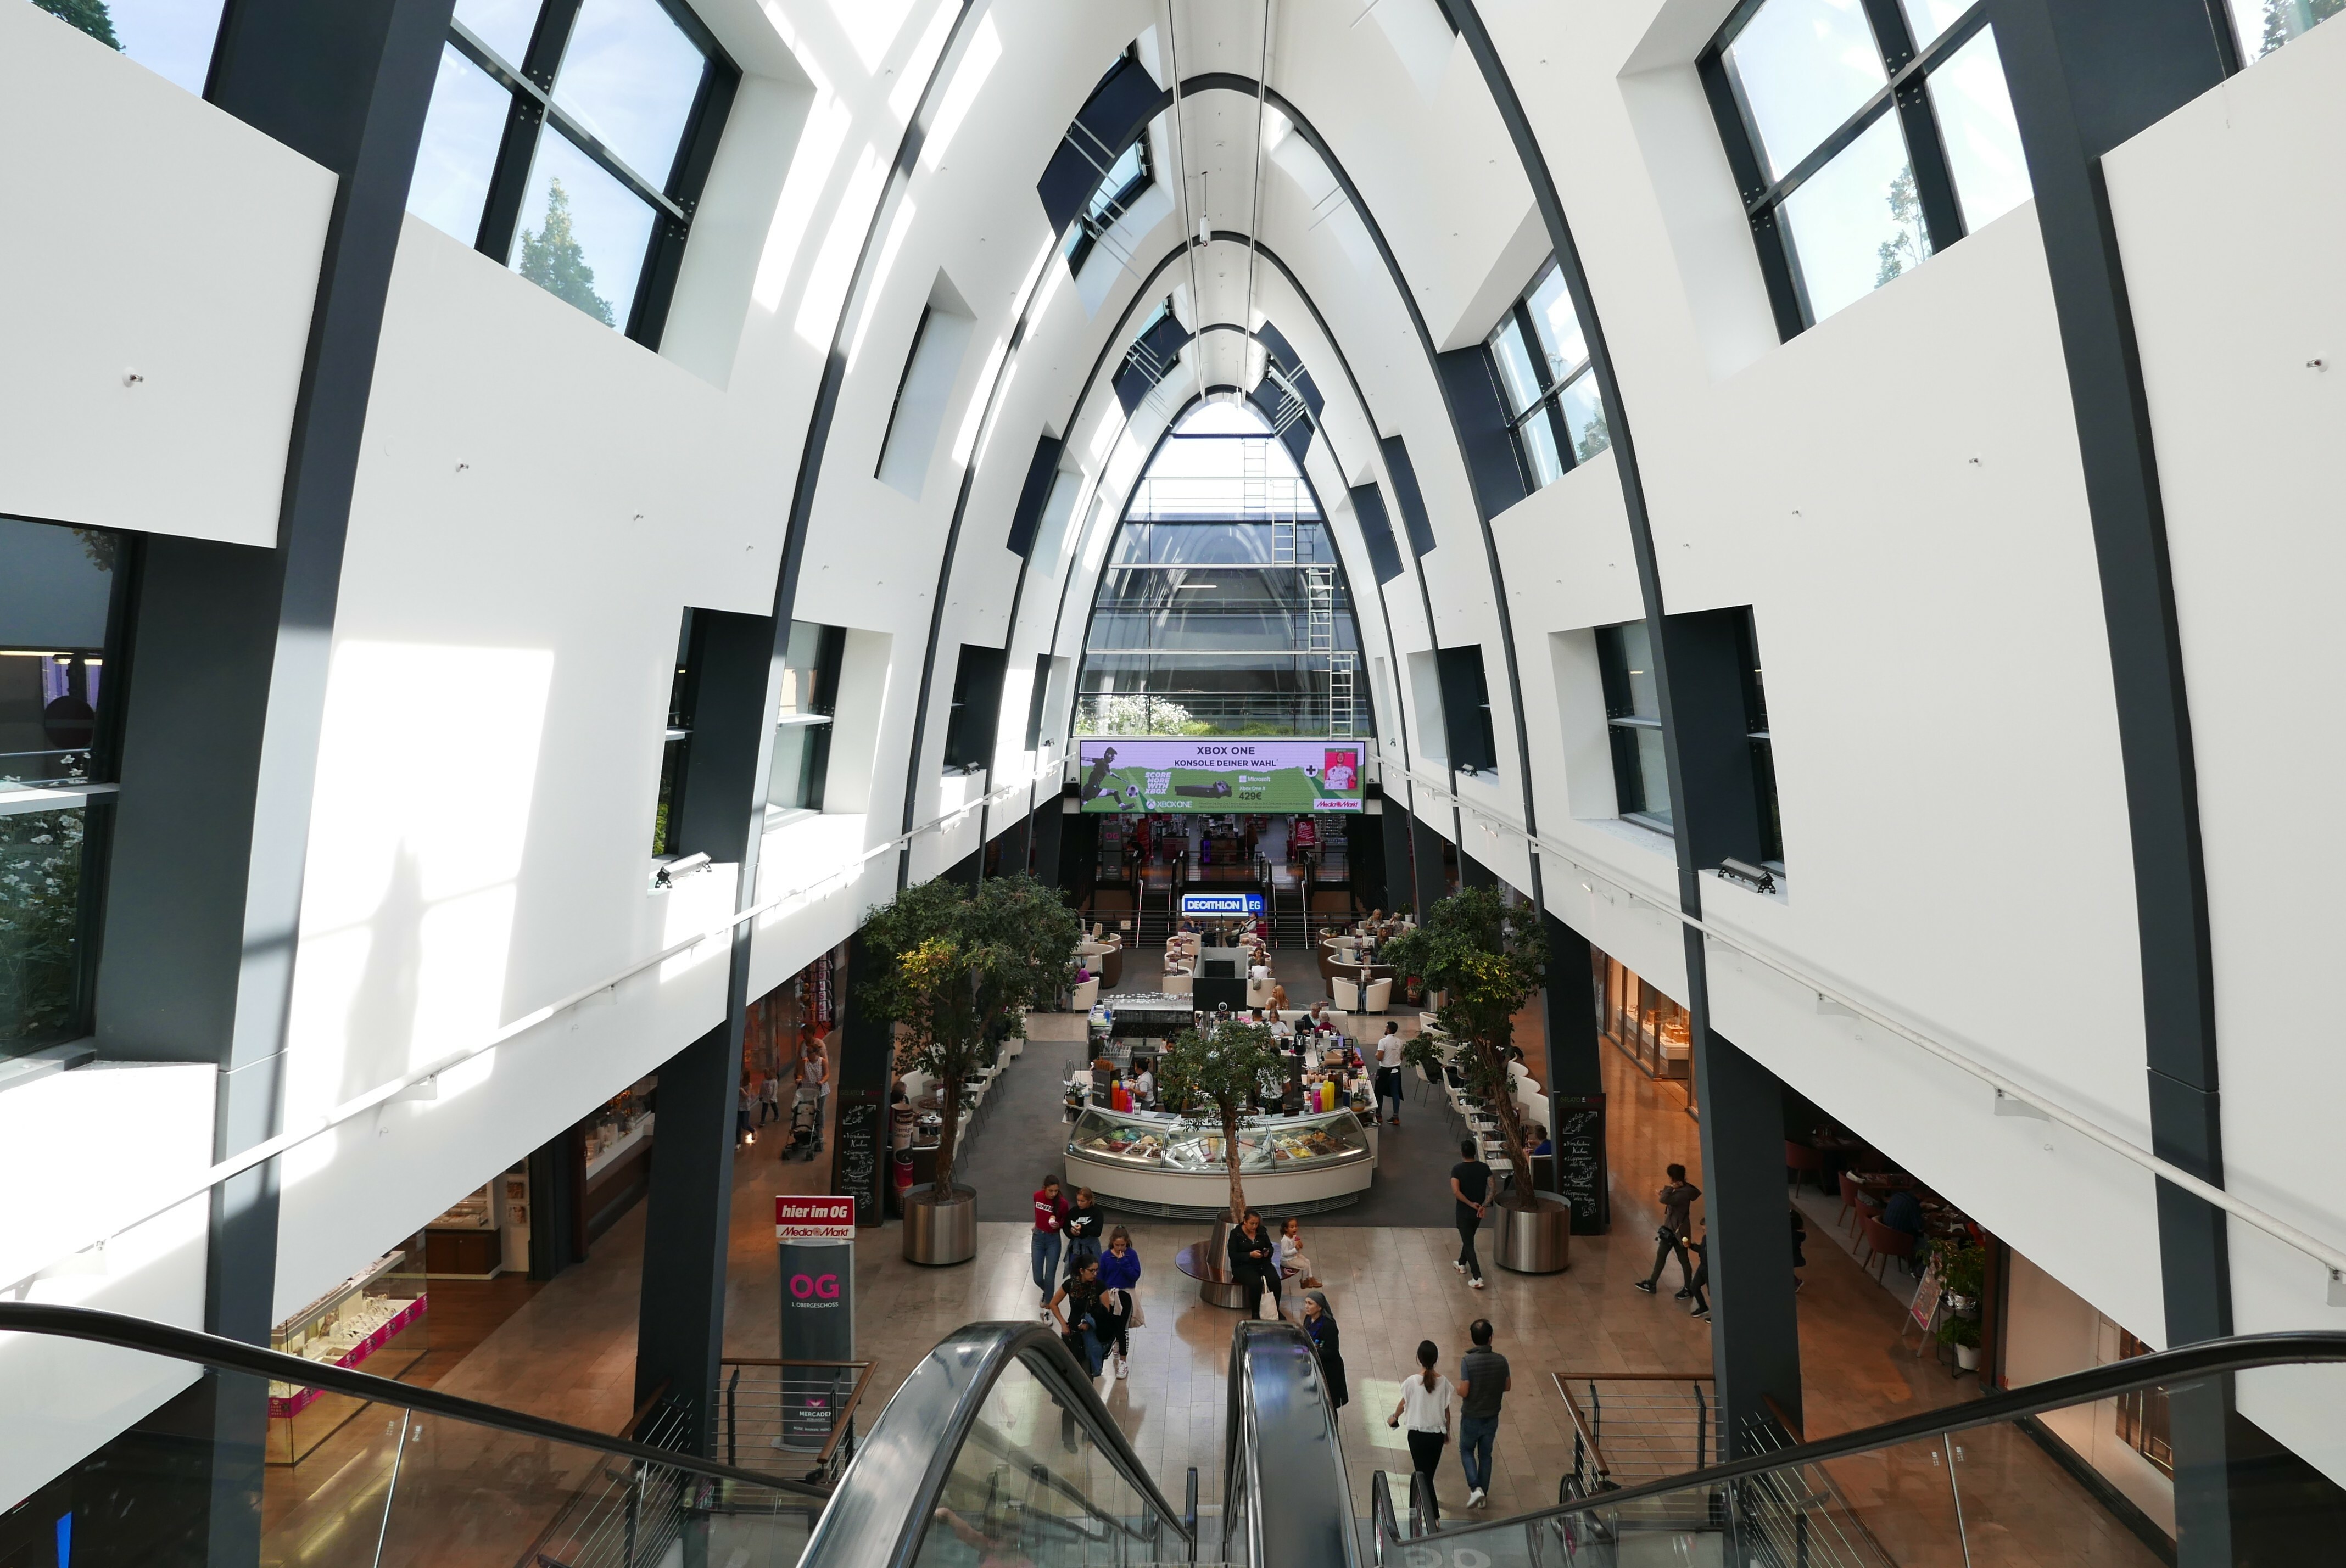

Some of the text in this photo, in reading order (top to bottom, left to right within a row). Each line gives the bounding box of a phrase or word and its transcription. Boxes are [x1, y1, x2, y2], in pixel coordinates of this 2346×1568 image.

[1197, 747, 1255, 755] XBOX ONE
[1239, 792, 1262, 800] 429€
[1187, 900, 1261, 910] DECATHLON EG
[781, 1205, 848, 1218] hier im OG
[790, 1274, 840, 1299] OG
